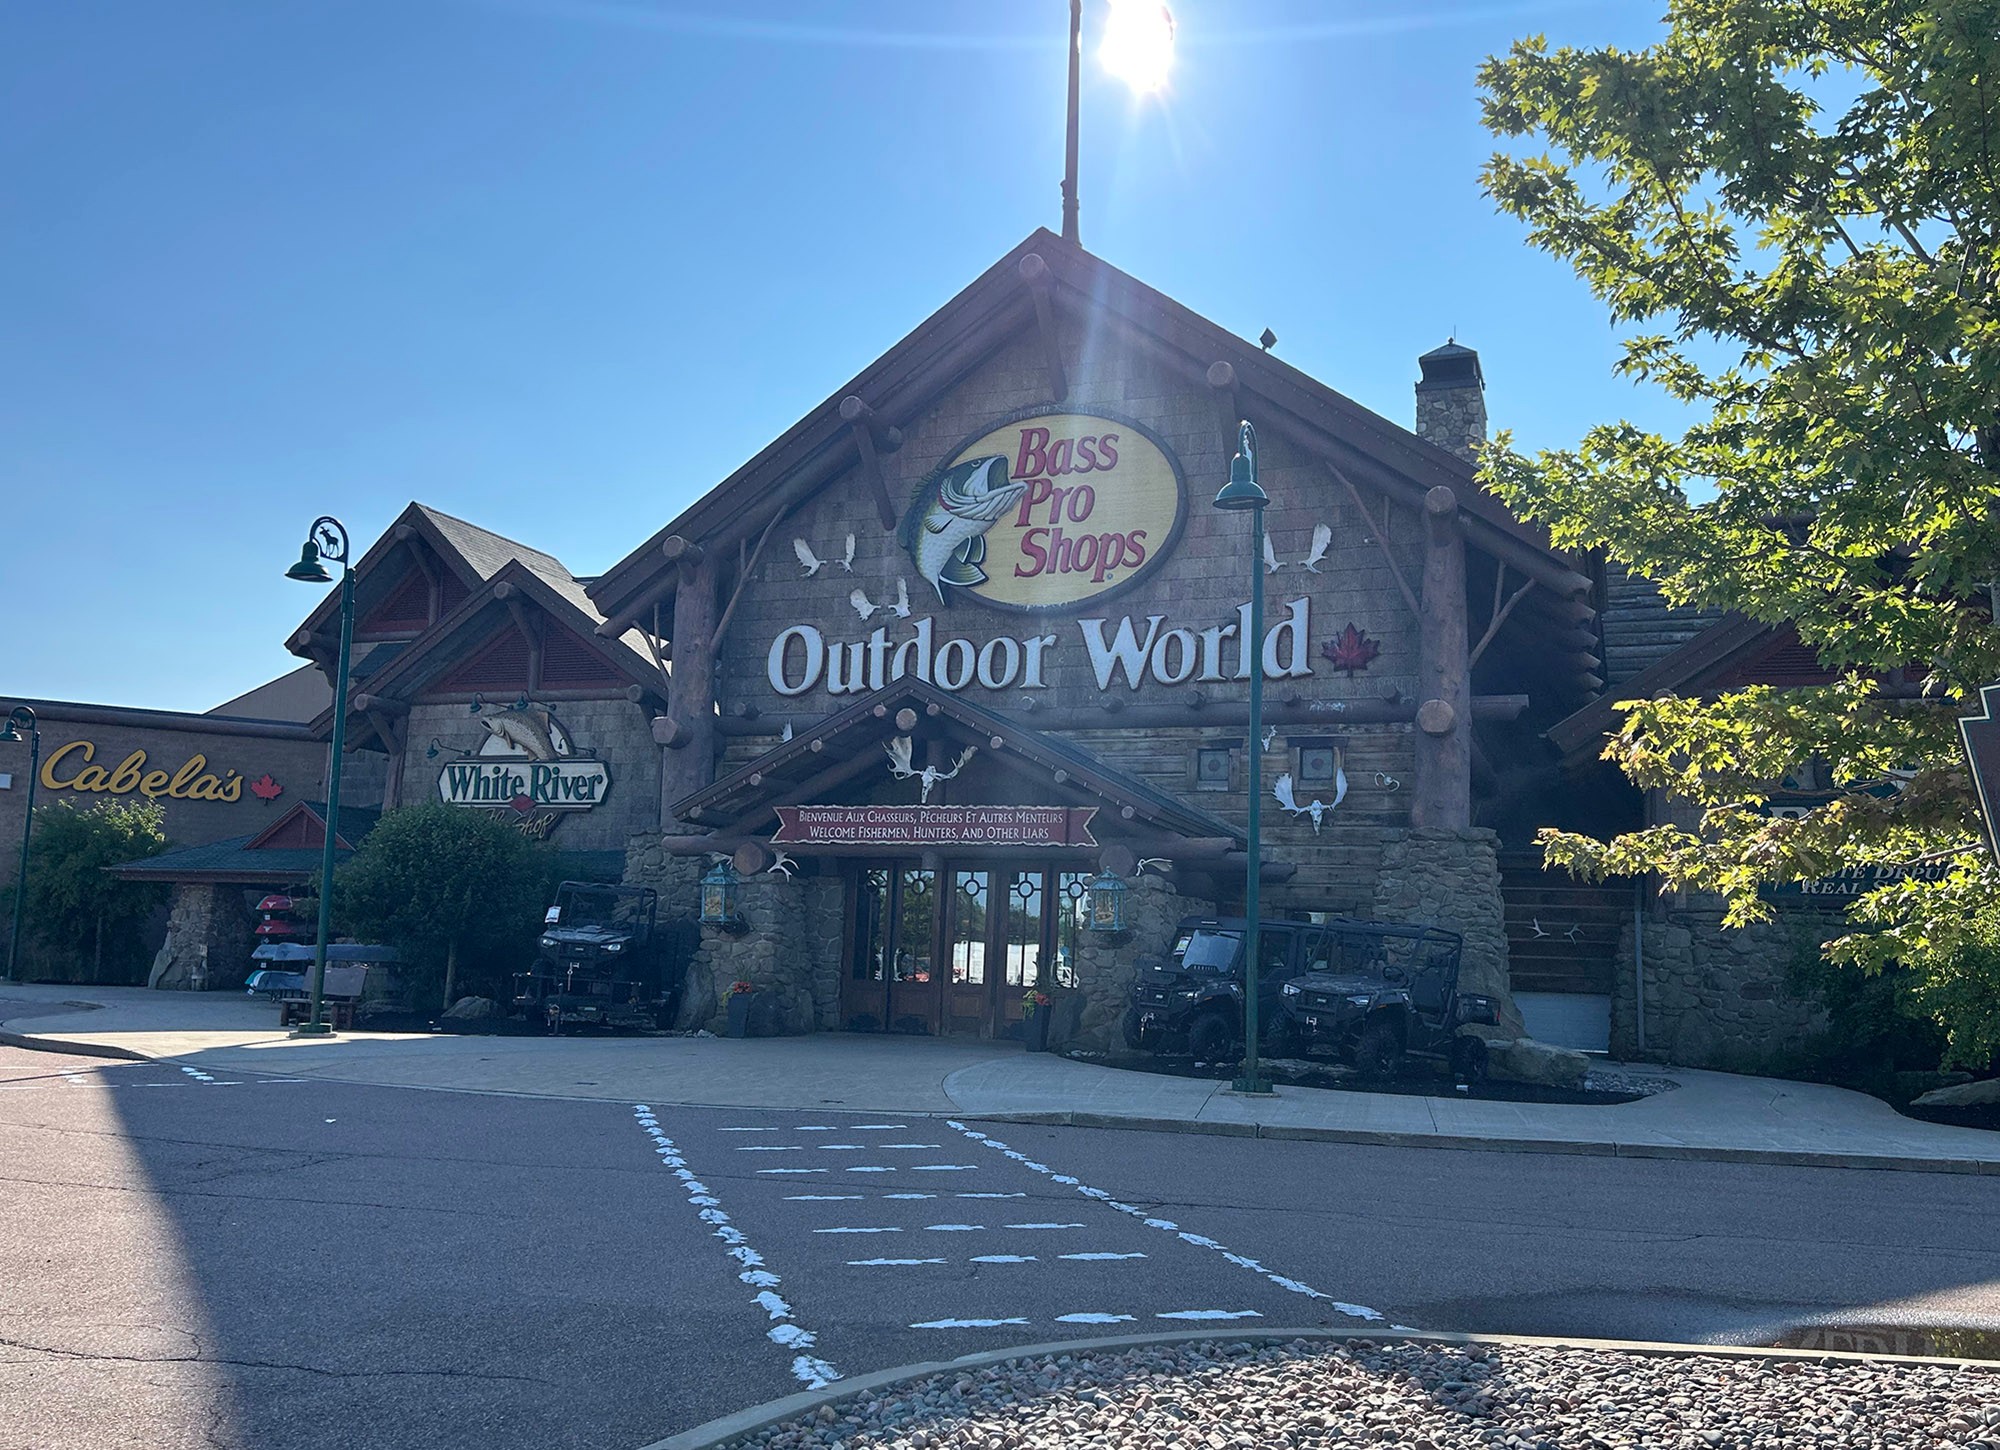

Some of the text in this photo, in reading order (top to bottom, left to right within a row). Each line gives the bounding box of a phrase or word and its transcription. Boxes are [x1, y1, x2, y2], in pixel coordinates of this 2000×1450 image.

[1010, 427, 1120, 480] Bass
[1014, 478, 1096, 528] Pro
[1014, 528, 1148, 583] Shops
[767, 596, 1315, 696] Outdoor World
[40, 740, 244, 802] Cabela's
[447, 764, 603, 804] White River
[512, 808, 558, 839] Shop
